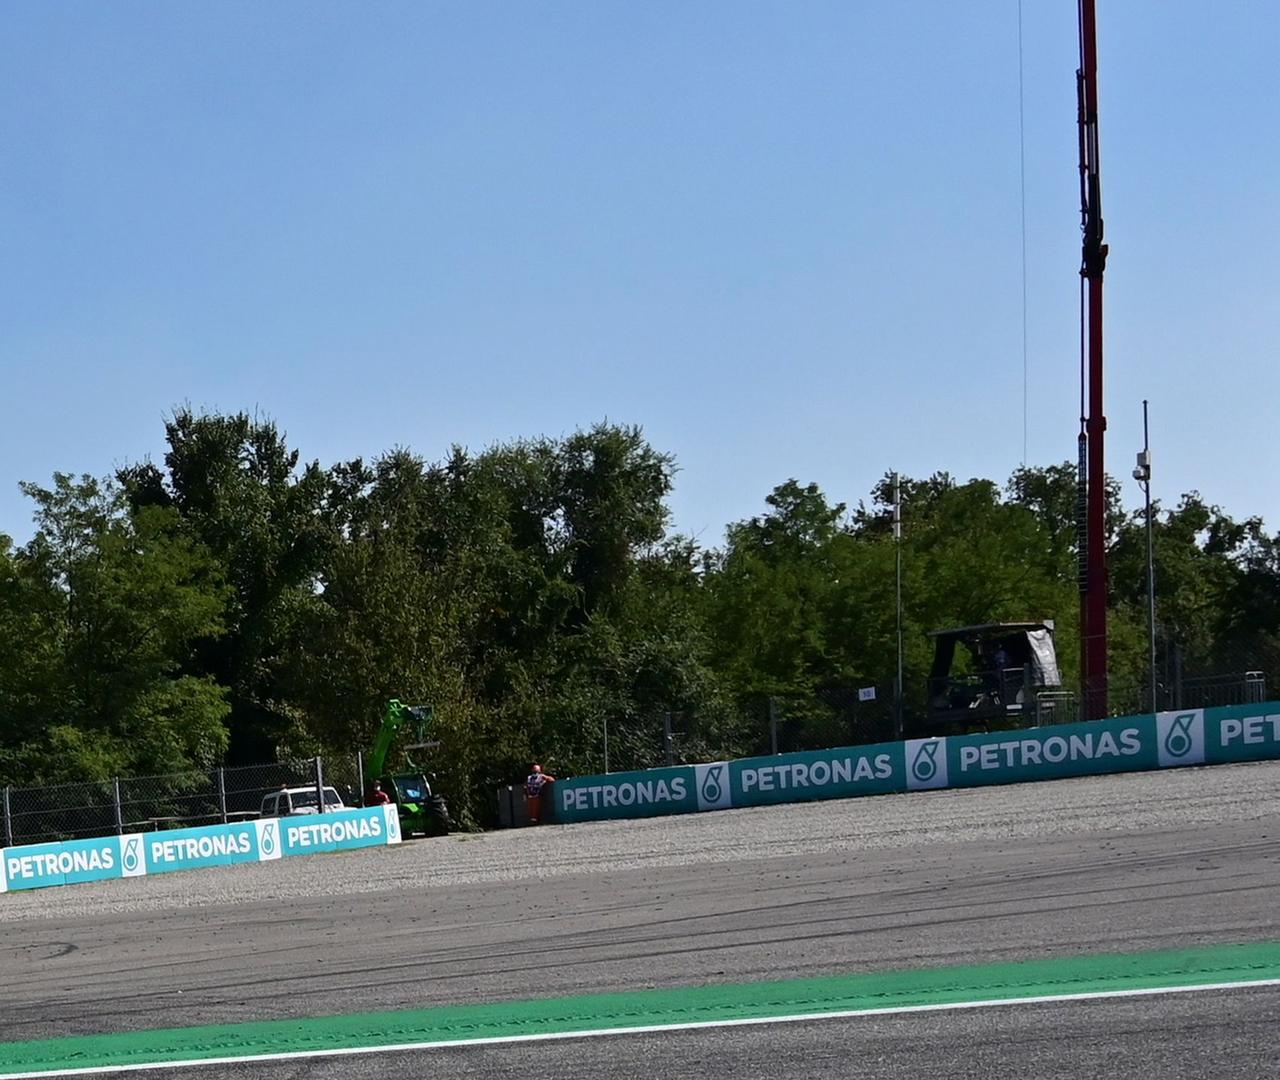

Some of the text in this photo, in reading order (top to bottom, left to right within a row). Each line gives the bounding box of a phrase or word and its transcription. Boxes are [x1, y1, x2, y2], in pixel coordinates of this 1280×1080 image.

[961, 728, 1141, 771] PETRONAS
[741, 754, 892, 792] PETRONAS
[563, 777, 687, 811] PETRONAS
[151, 832, 250, 863] PETRONAS
[288, 816, 382, 846] PETRONAS
[8, 847, 114, 879] PETRONAS
